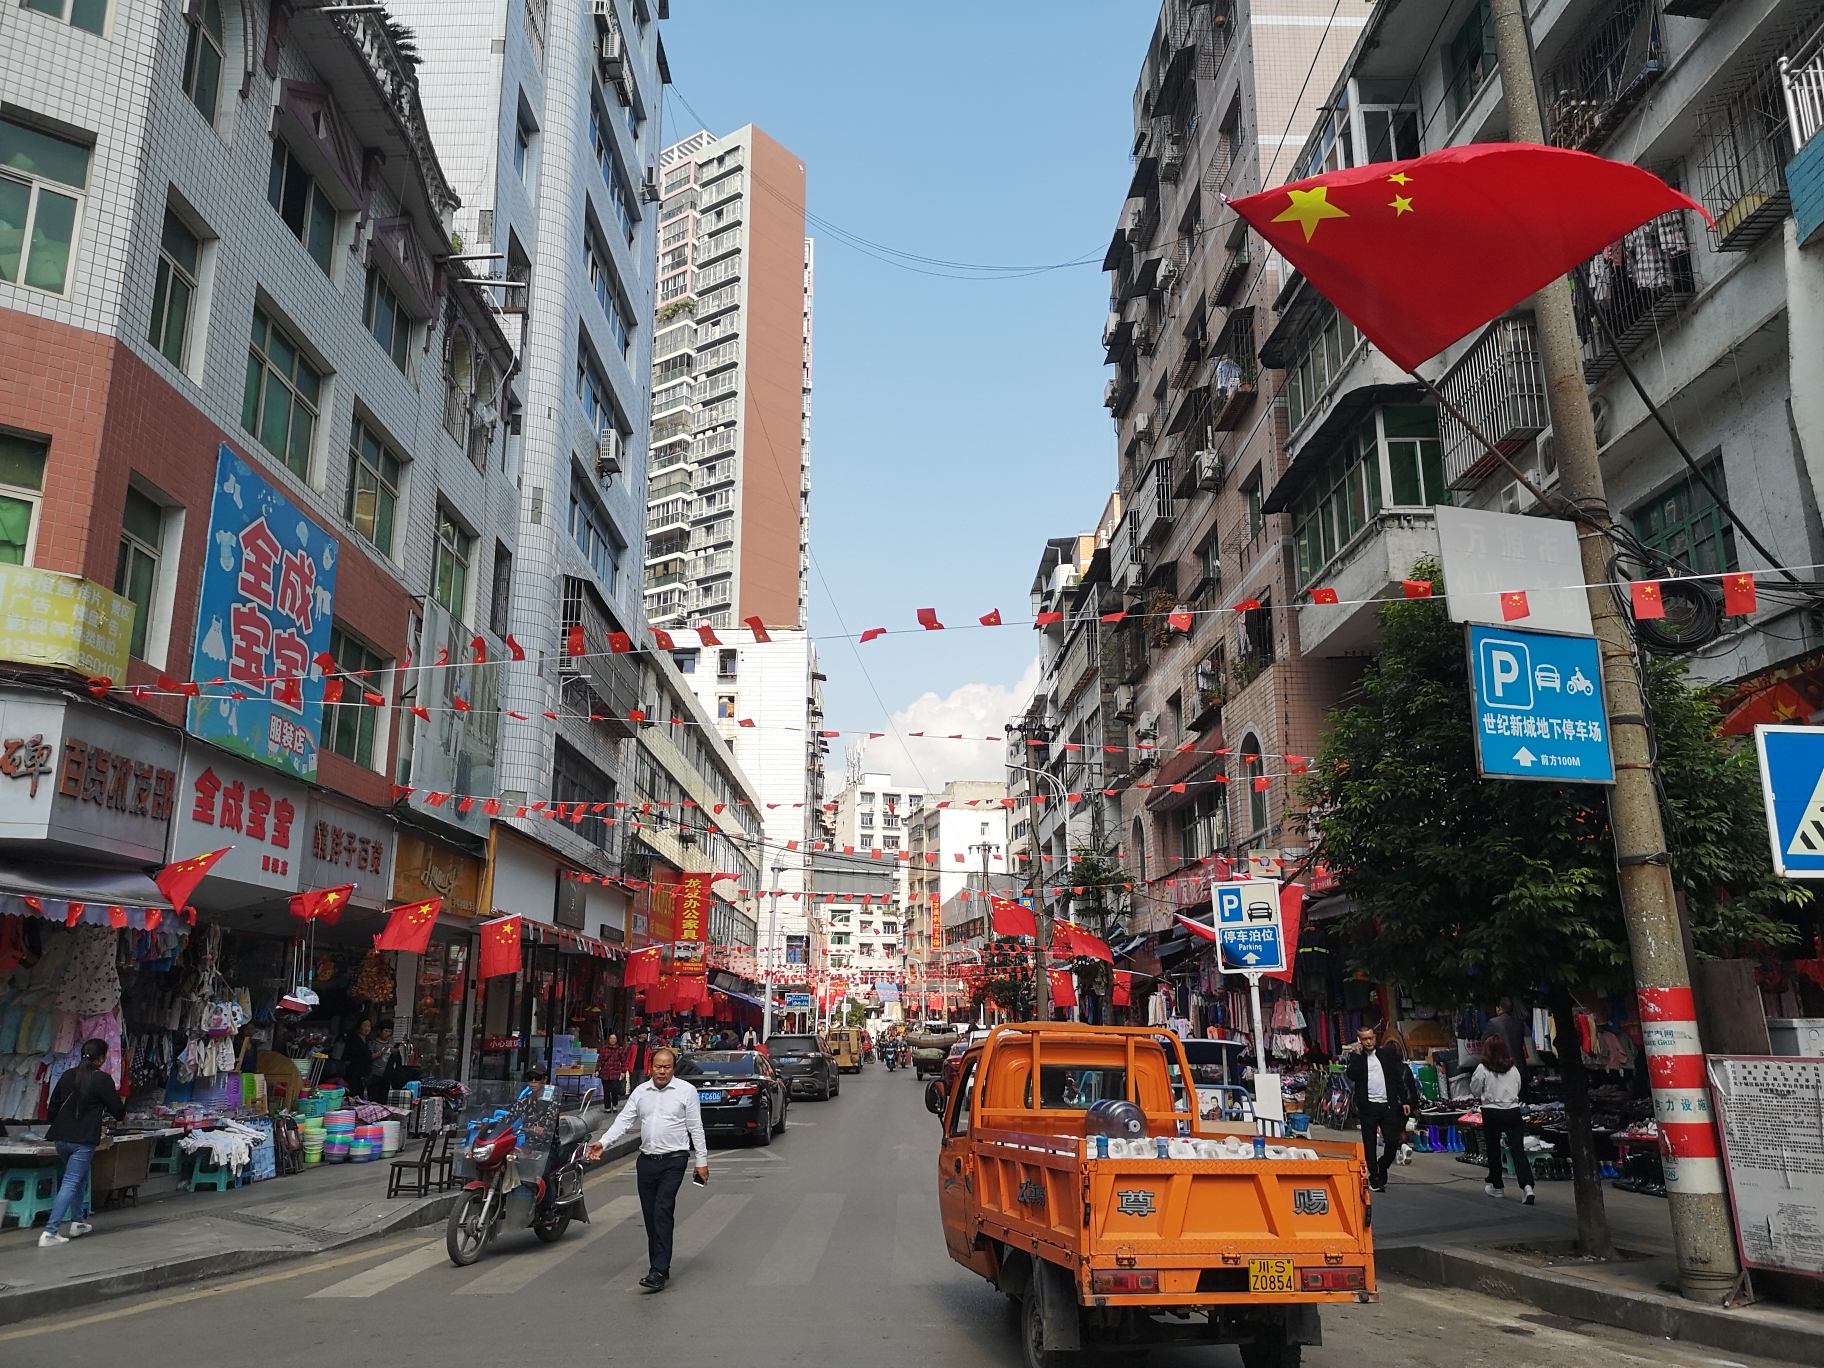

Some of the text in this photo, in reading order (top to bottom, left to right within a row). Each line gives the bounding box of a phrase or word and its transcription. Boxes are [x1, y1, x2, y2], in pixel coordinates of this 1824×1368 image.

[237, 515, 317, 636] 全成
[228, 601, 310, 716] 宝宝
[1492, 650, 1519, 697] P
[268, 712, 307, 756] 服装店
[1483, 712, 1602, 742] 世纪新城地下停车场
[1540, 753, 1581, 767] 前方100M
[58, 735, 176, 821] 百货批发部
[191, 766, 296, 850] 全成宝宝
[312, 819, 384, 876] 熊胖子百货
[1223, 894, 1239, 917] P
[1223, 928, 1275, 944] 停车泊位
[1238, 942, 1263, 952] Parking
[1117, 1188, 1330, 1217] 尊 赐
[1258, 1260, 1286, 1273] 川·S
[1251, 1274, 1293, 1290] Z0854
